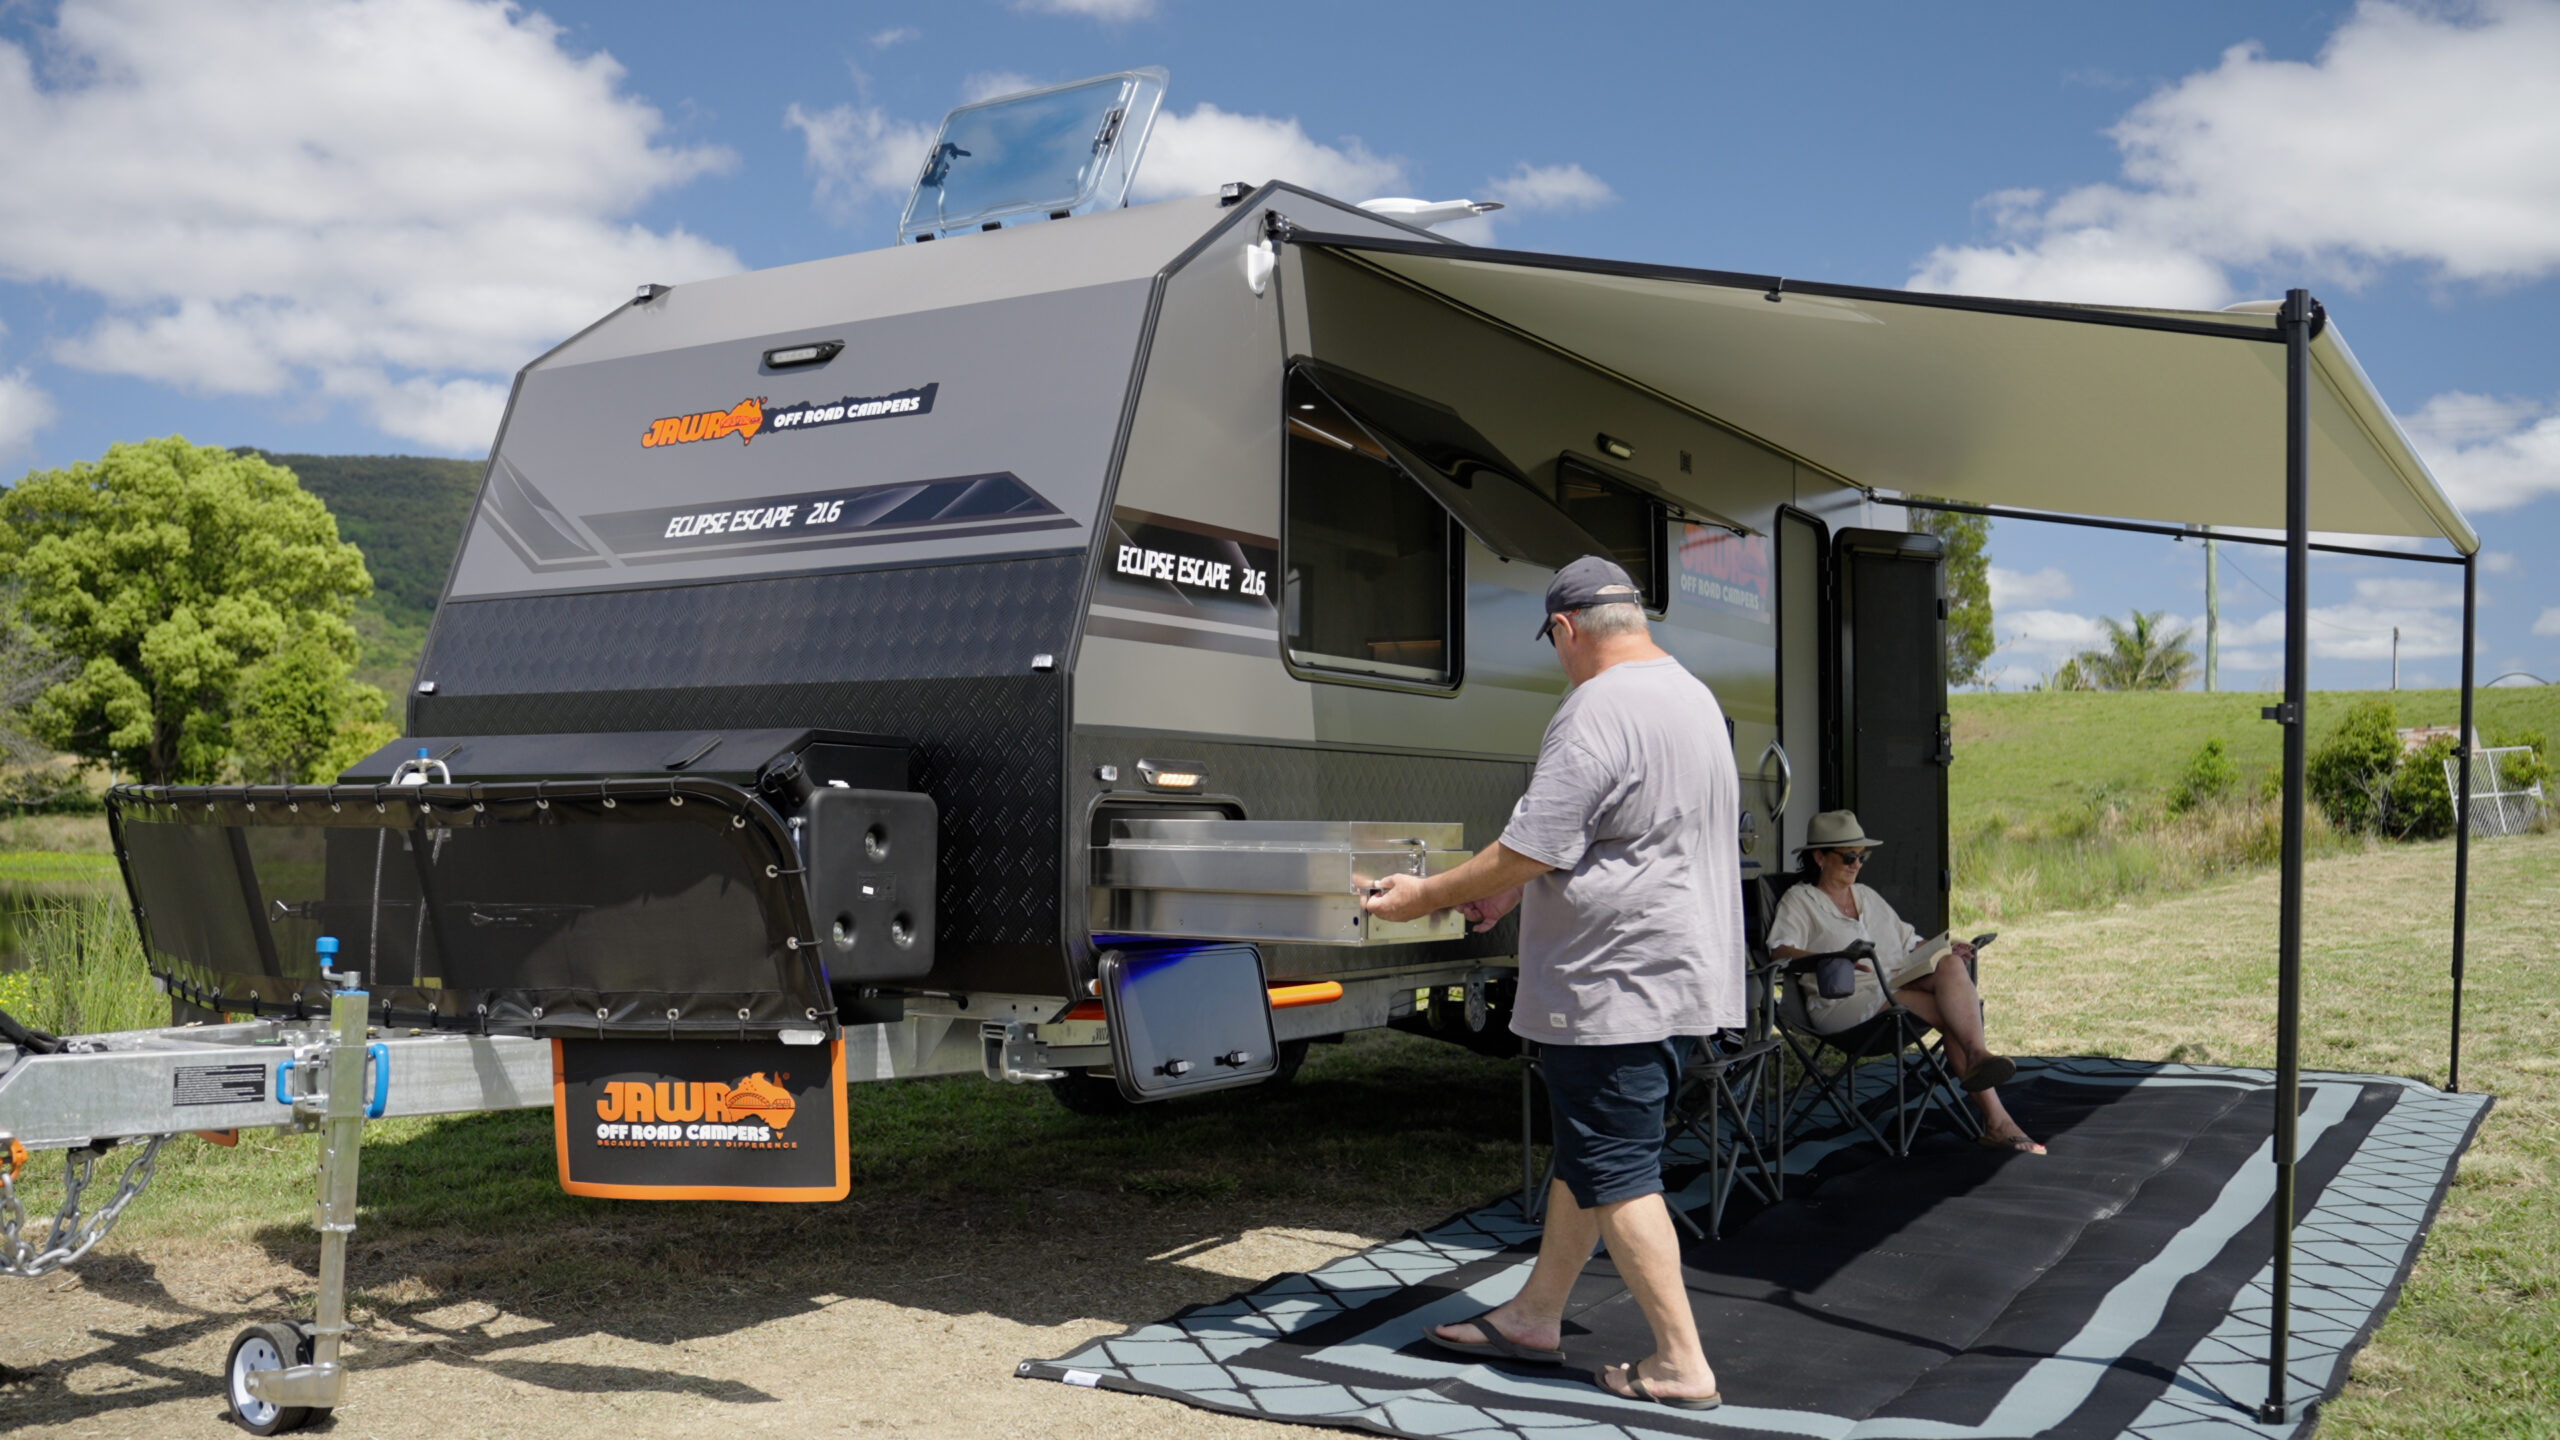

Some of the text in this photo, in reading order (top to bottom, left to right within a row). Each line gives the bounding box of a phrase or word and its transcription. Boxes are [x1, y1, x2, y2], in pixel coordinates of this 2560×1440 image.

[774, 397, 921, 428] OFF ROAD CAMPERS
[665, 500, 844, 538] ECLIPSE ESCAPE 21.6
[1117, 544, 1267, 596] ECLIPSE ESCAPE 21.6
[1680, 574, 1759, 610] OFF ROAD CAMPERS
[596, 1124, 771, 1142] OFF ROAD CAMPERS
[597, 1140, 646, 1148] BECAUSE
